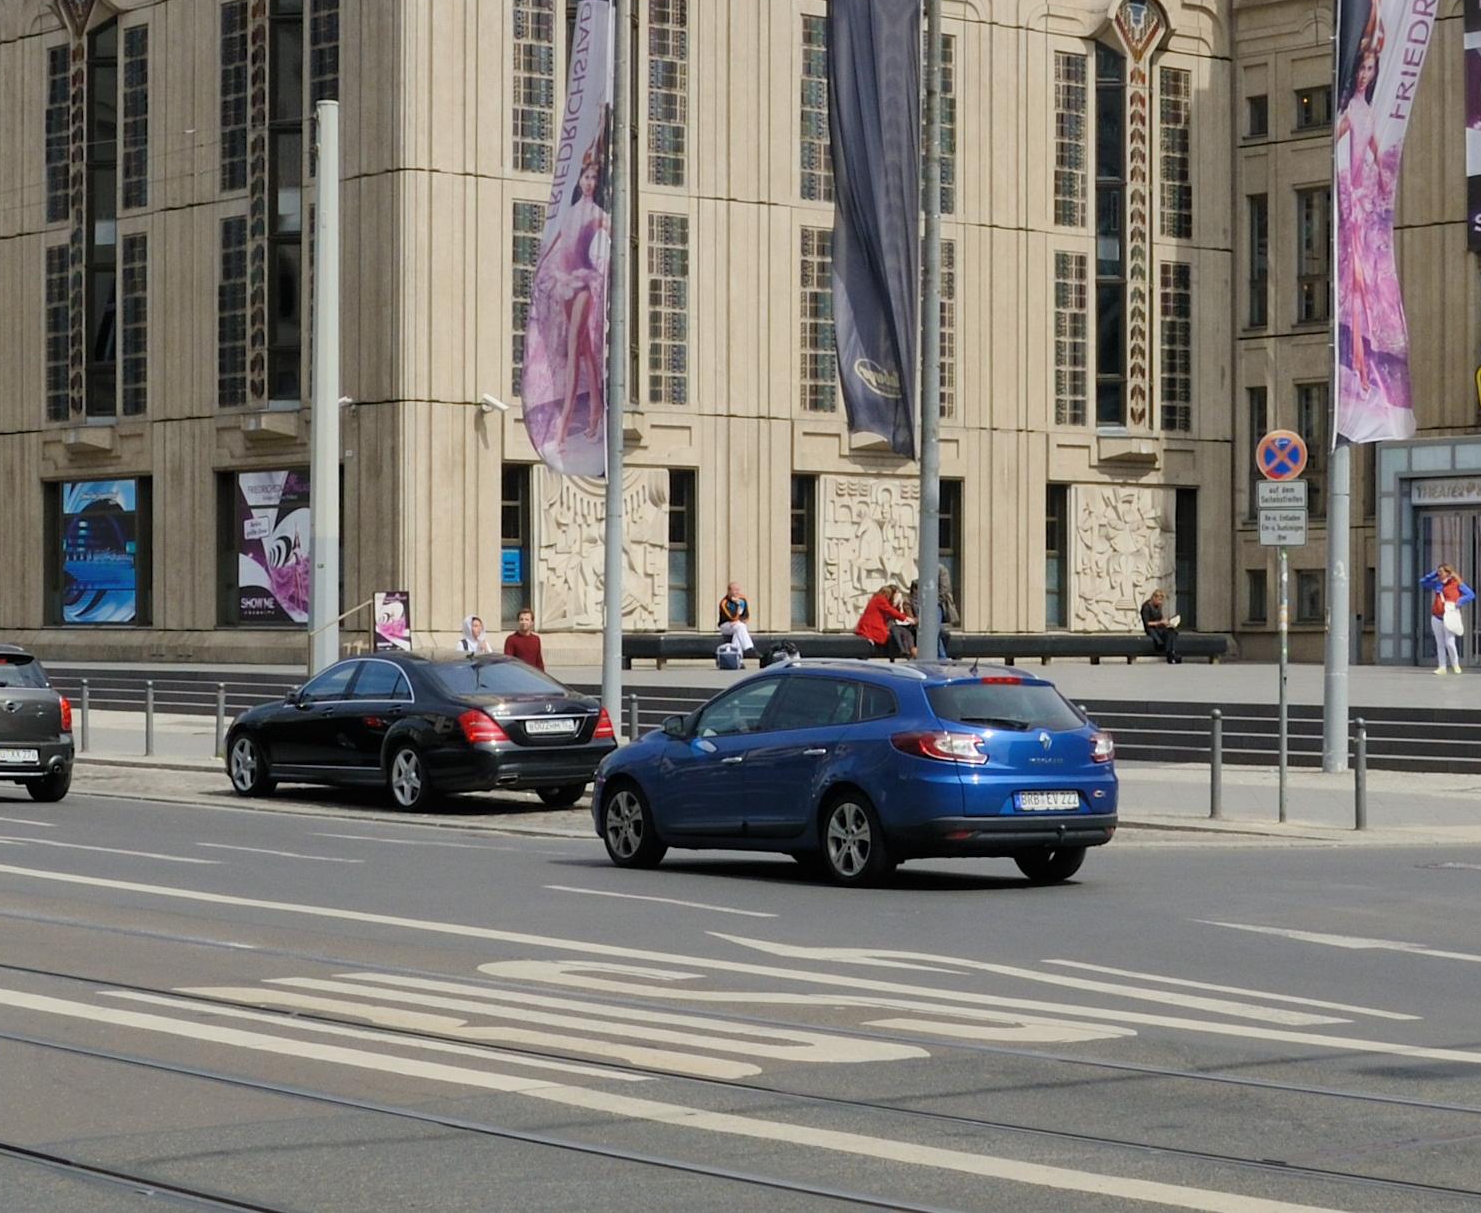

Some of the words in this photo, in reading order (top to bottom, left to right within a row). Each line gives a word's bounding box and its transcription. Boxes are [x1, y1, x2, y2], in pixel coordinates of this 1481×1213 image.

[1021, 791, 1040, 806] BRB
[1046, 791, 1059, 805] EV
[1061, 791, 1078, 805] 222
